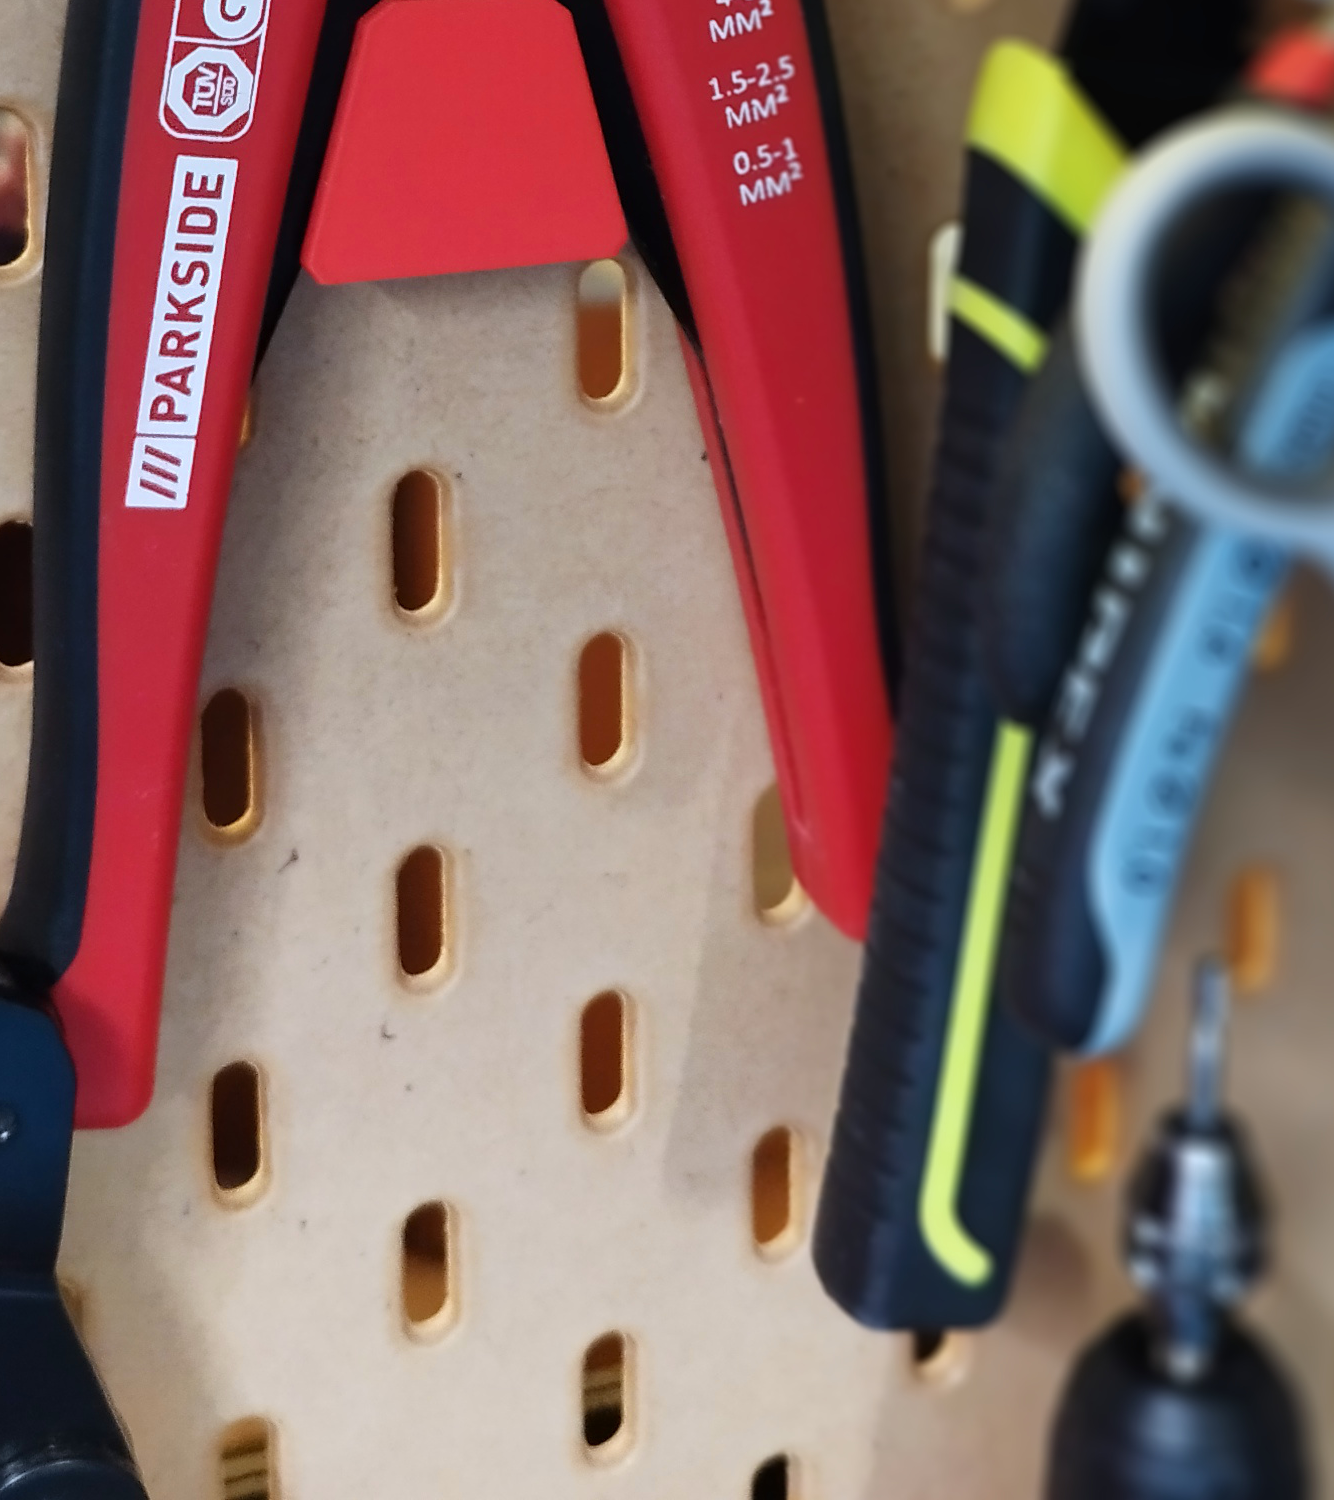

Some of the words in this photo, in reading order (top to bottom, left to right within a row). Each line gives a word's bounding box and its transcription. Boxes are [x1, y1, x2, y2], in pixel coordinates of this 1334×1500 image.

[191, 64, 218, 111] TÜV
[708, 55, 796, 102] 1.5-2.5
[733, 137, 799, 176] 0.5-1
[149, 171, 225, 423] PARKSIDE
